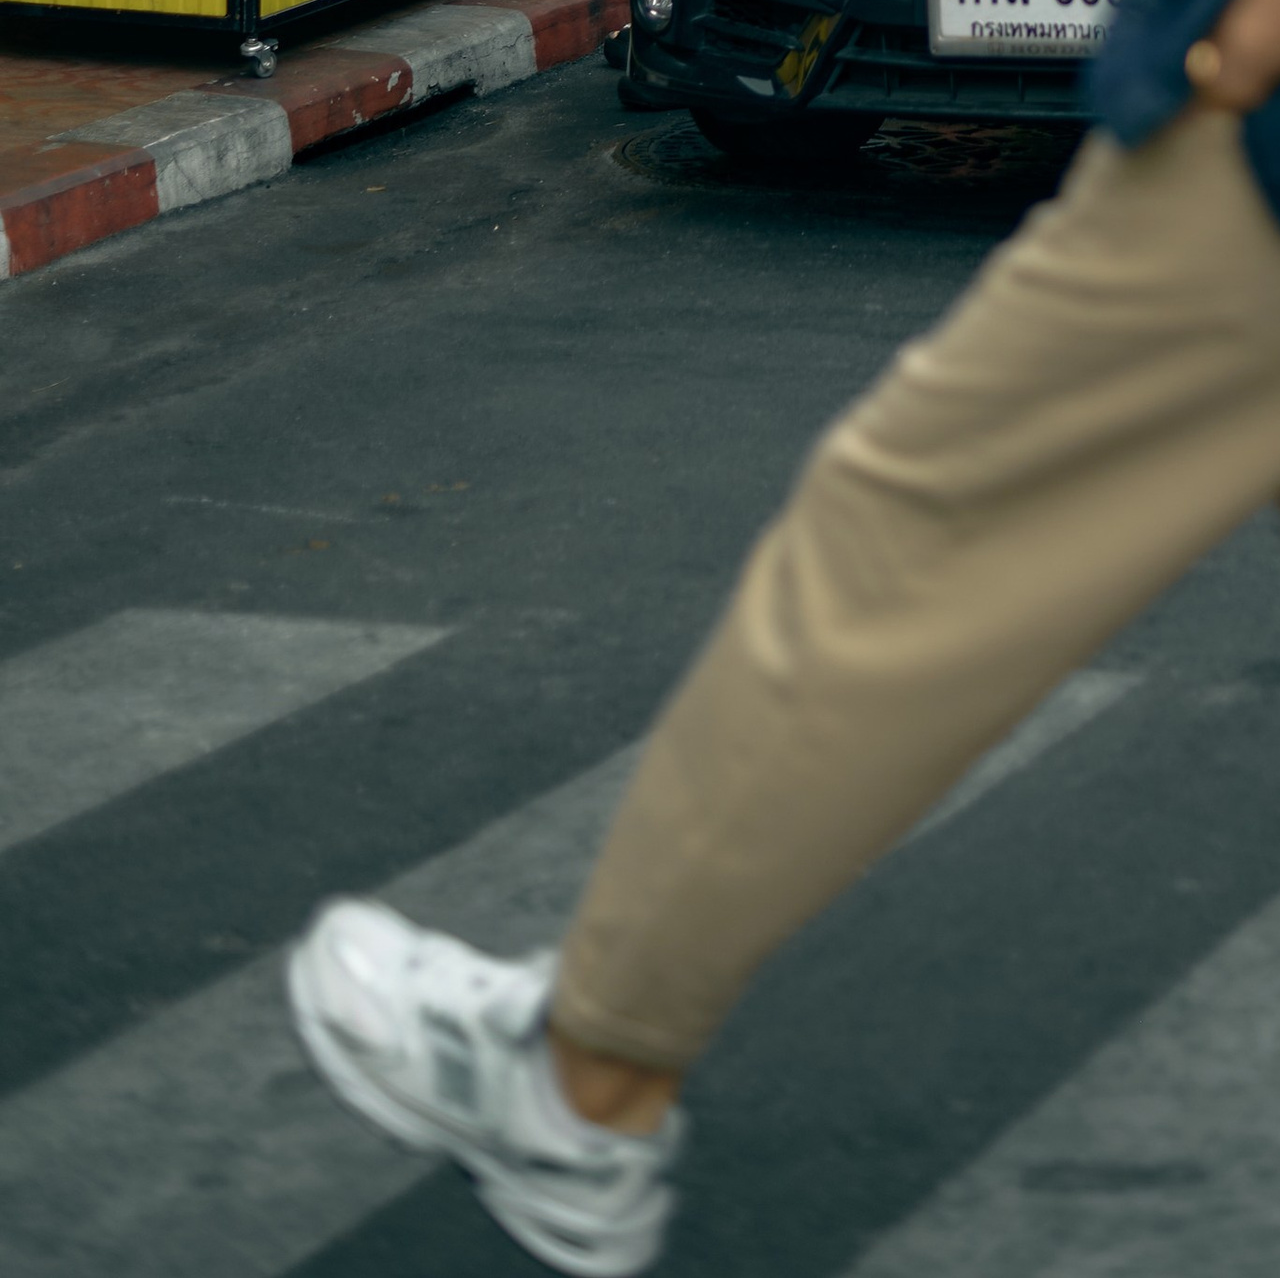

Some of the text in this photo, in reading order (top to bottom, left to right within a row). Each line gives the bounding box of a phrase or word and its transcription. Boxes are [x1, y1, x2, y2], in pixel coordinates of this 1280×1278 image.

[971, 20, 1107, 41] กรงเทพมหานค
